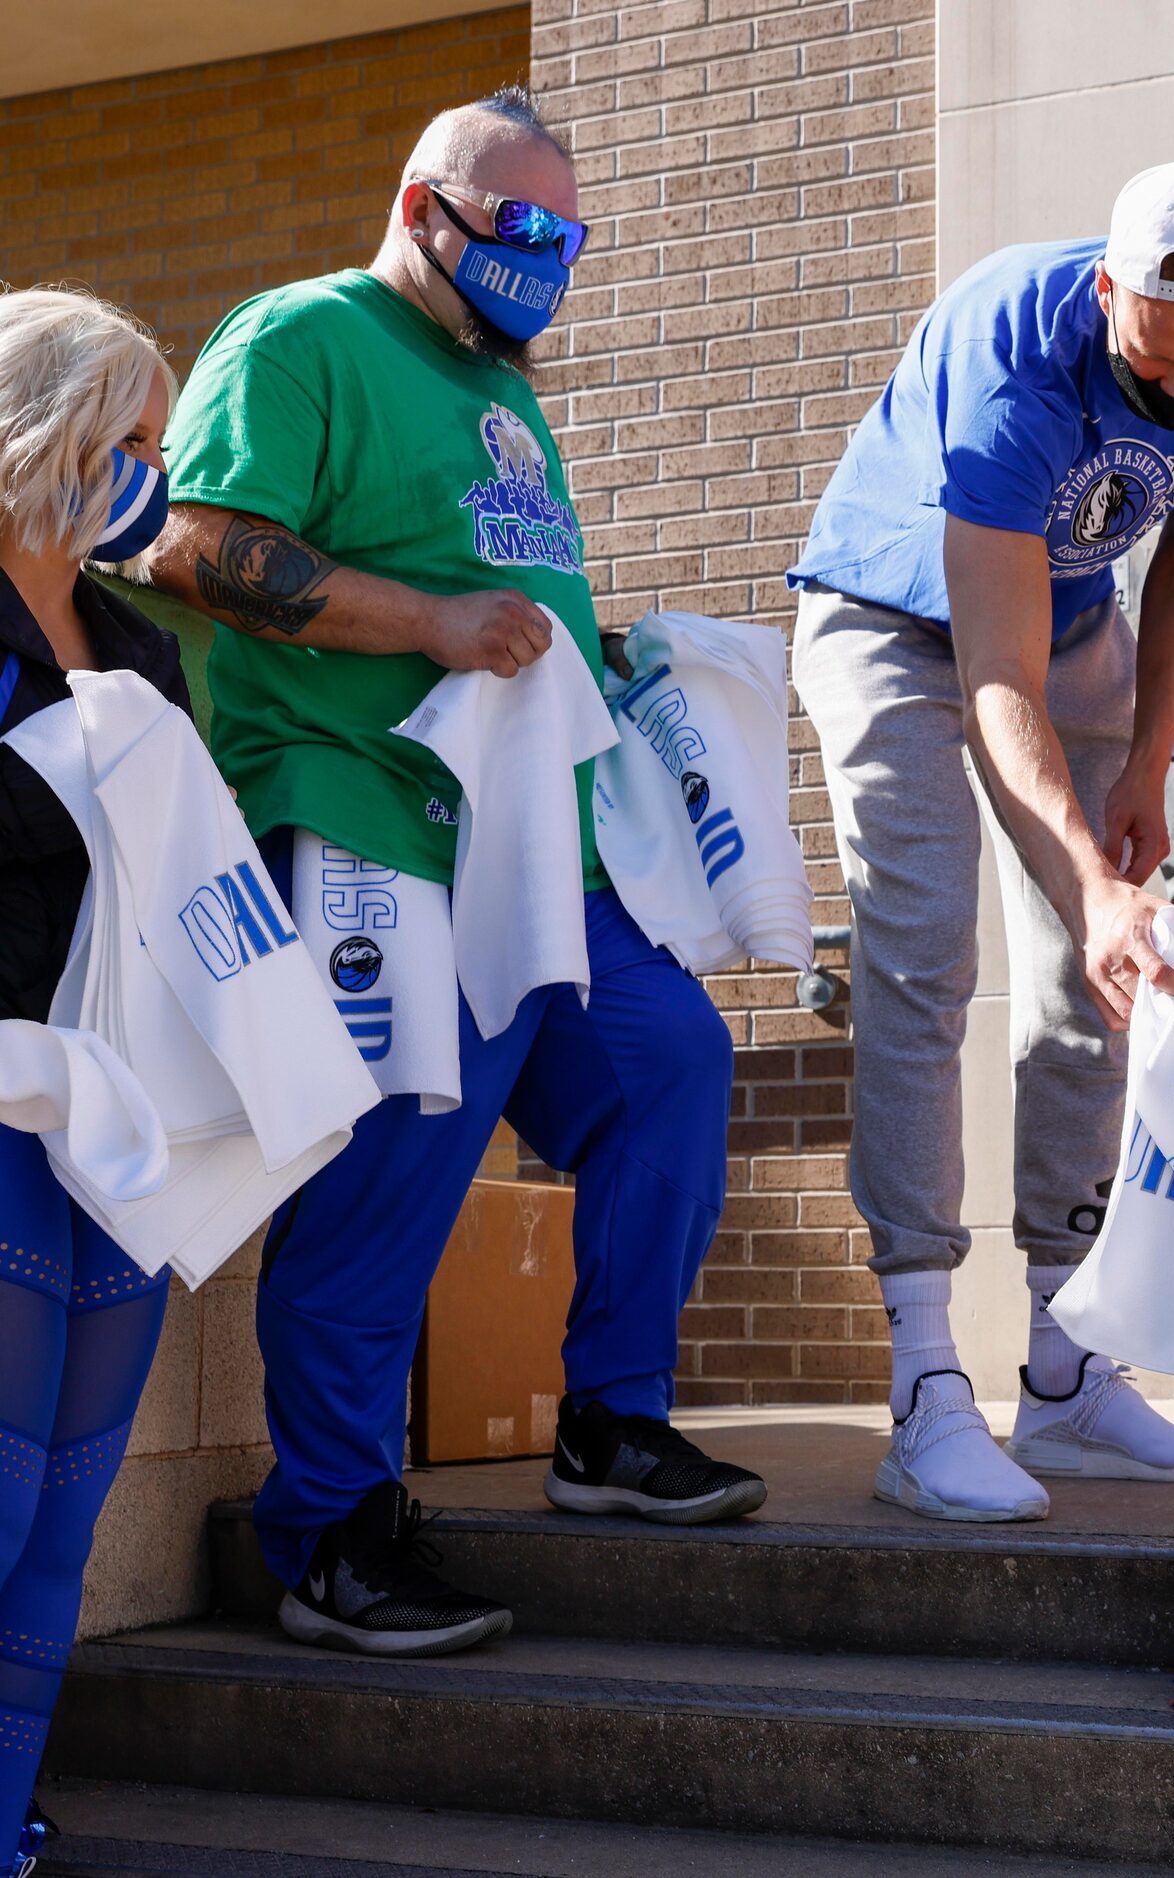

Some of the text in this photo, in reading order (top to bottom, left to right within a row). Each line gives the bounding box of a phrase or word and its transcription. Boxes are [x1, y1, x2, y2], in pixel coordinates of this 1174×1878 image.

[465, 249, 555, 310] DALLAS
[1057, 451, 1110, 521] NATIONAL
[1054, 534, 1127, 560] ASSOCIATION
